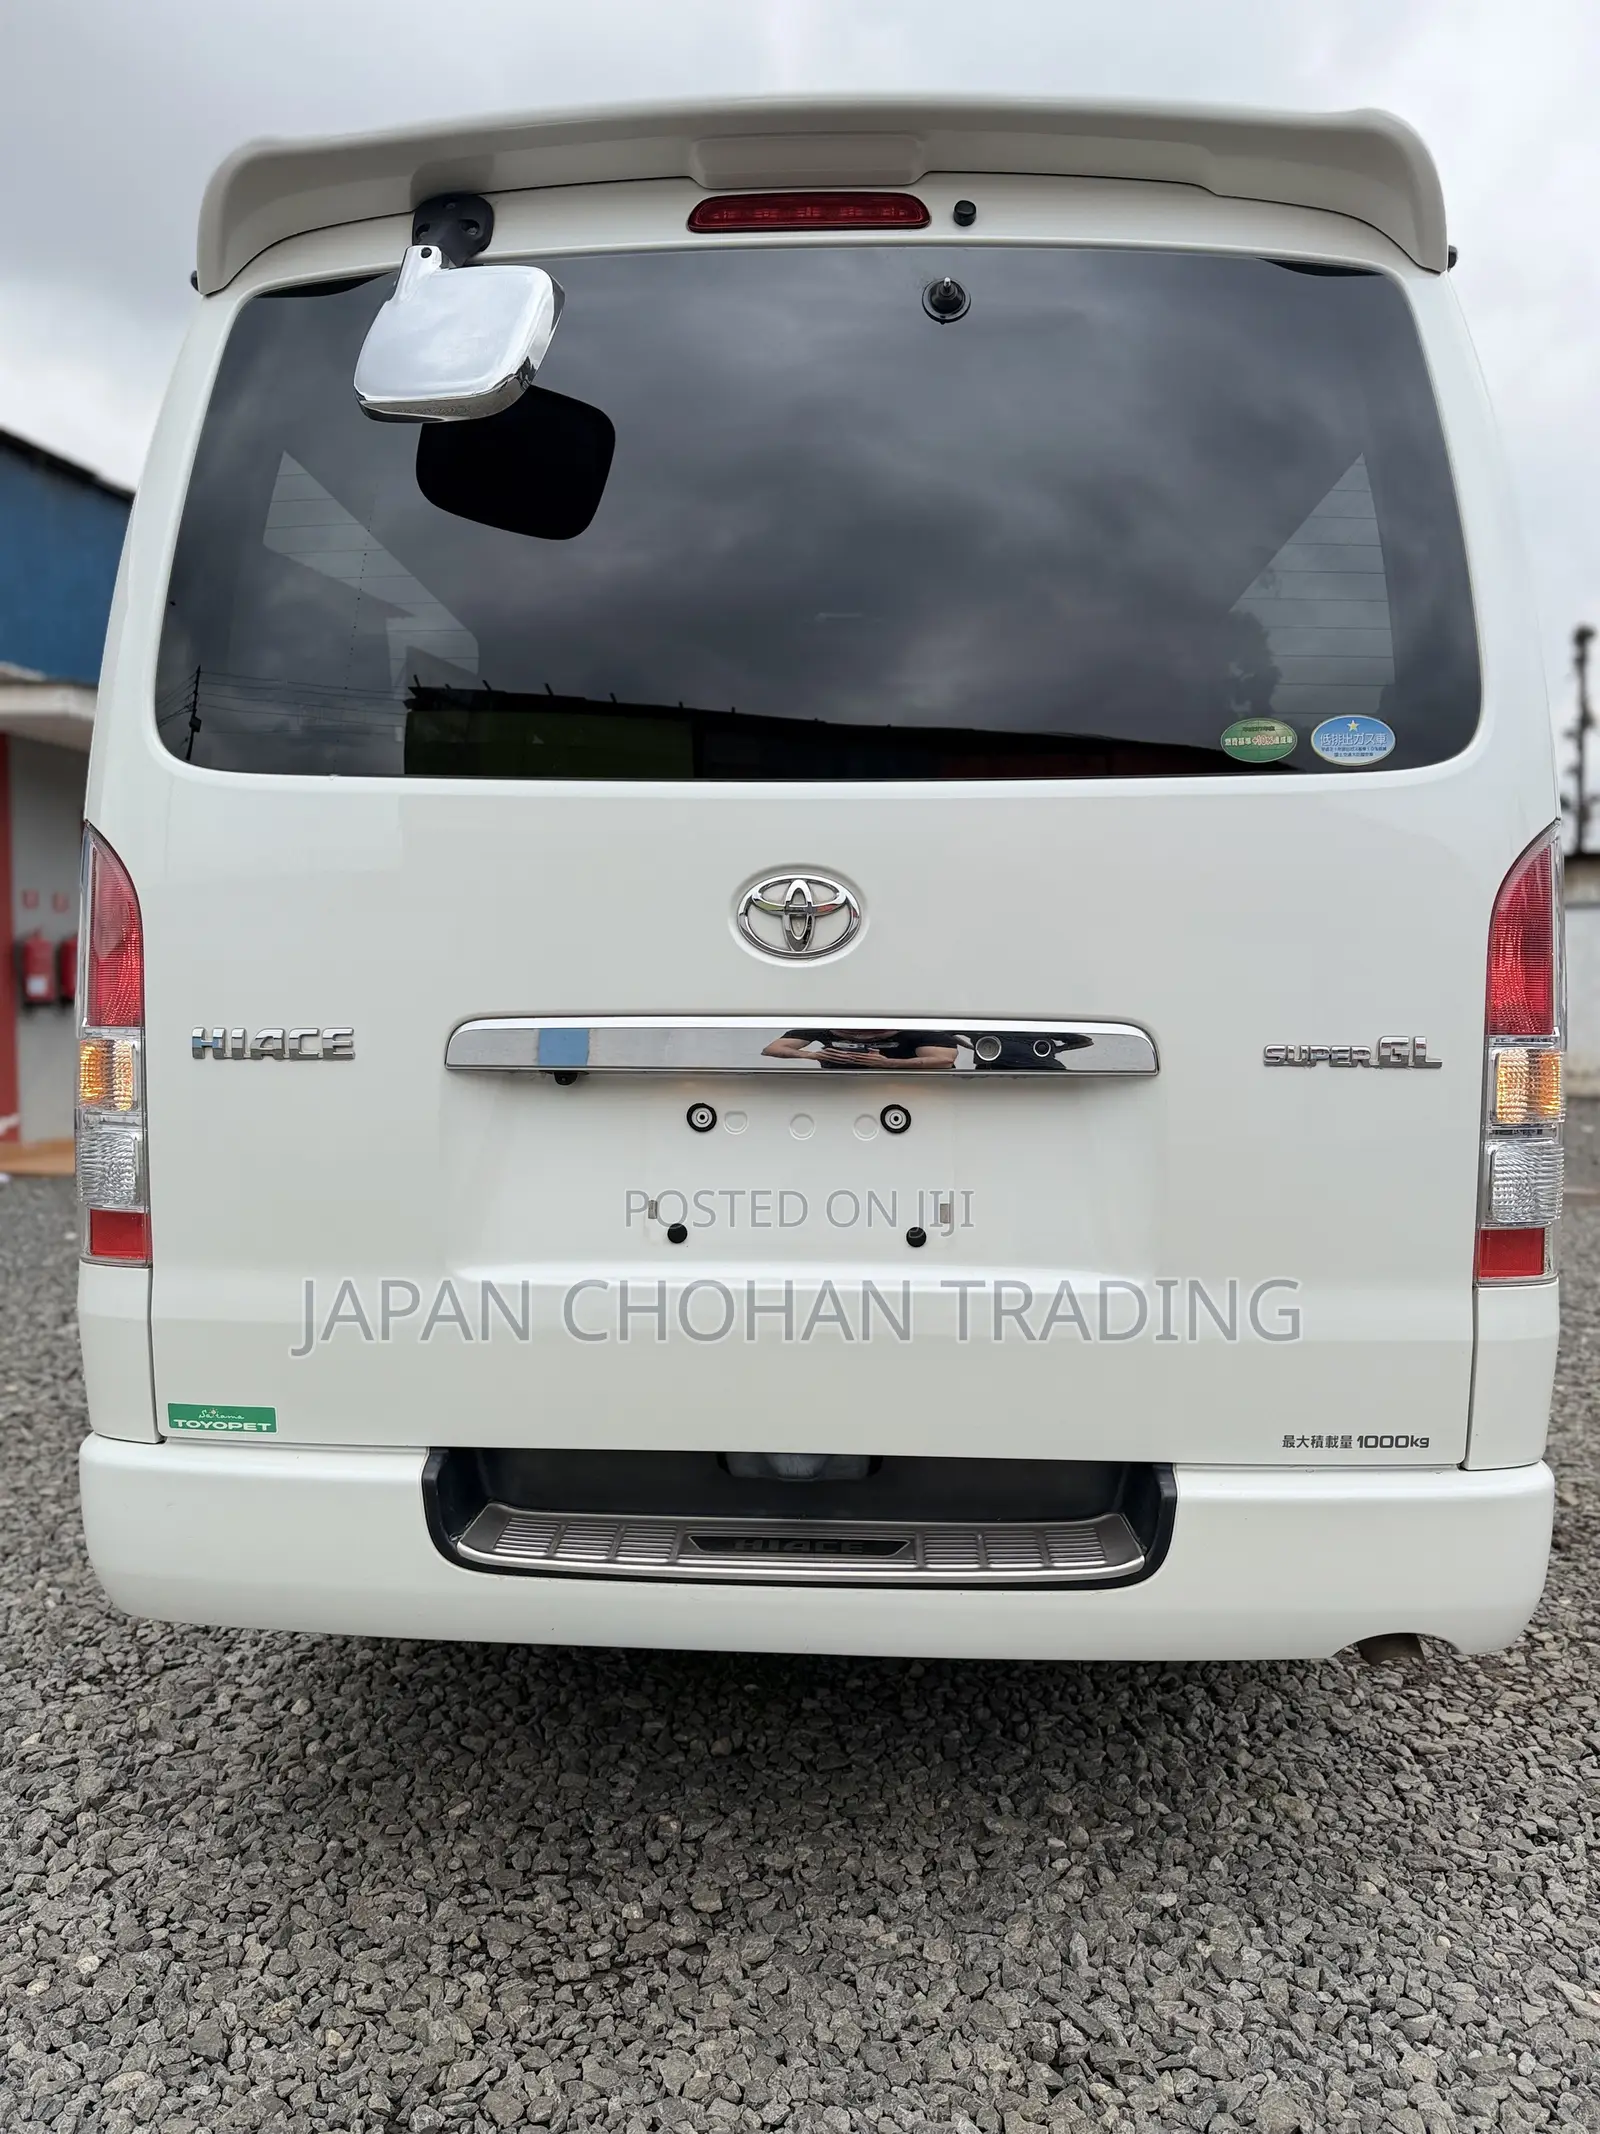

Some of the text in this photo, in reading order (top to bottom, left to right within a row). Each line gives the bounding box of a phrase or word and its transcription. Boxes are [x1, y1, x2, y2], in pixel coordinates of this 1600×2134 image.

[1320, 732, 1388, 747] 低排出ガス車
[192, 1027, 356, 1060] HIACE
[1264, 1036, 1443, 1069] SUPER GL
[173, 1419, 272, 1431] TOYOPET
[1282, 1435, 1430, 1449] 最大積載量 1000kg
[733, 1539, 864, 1554] HIACE
